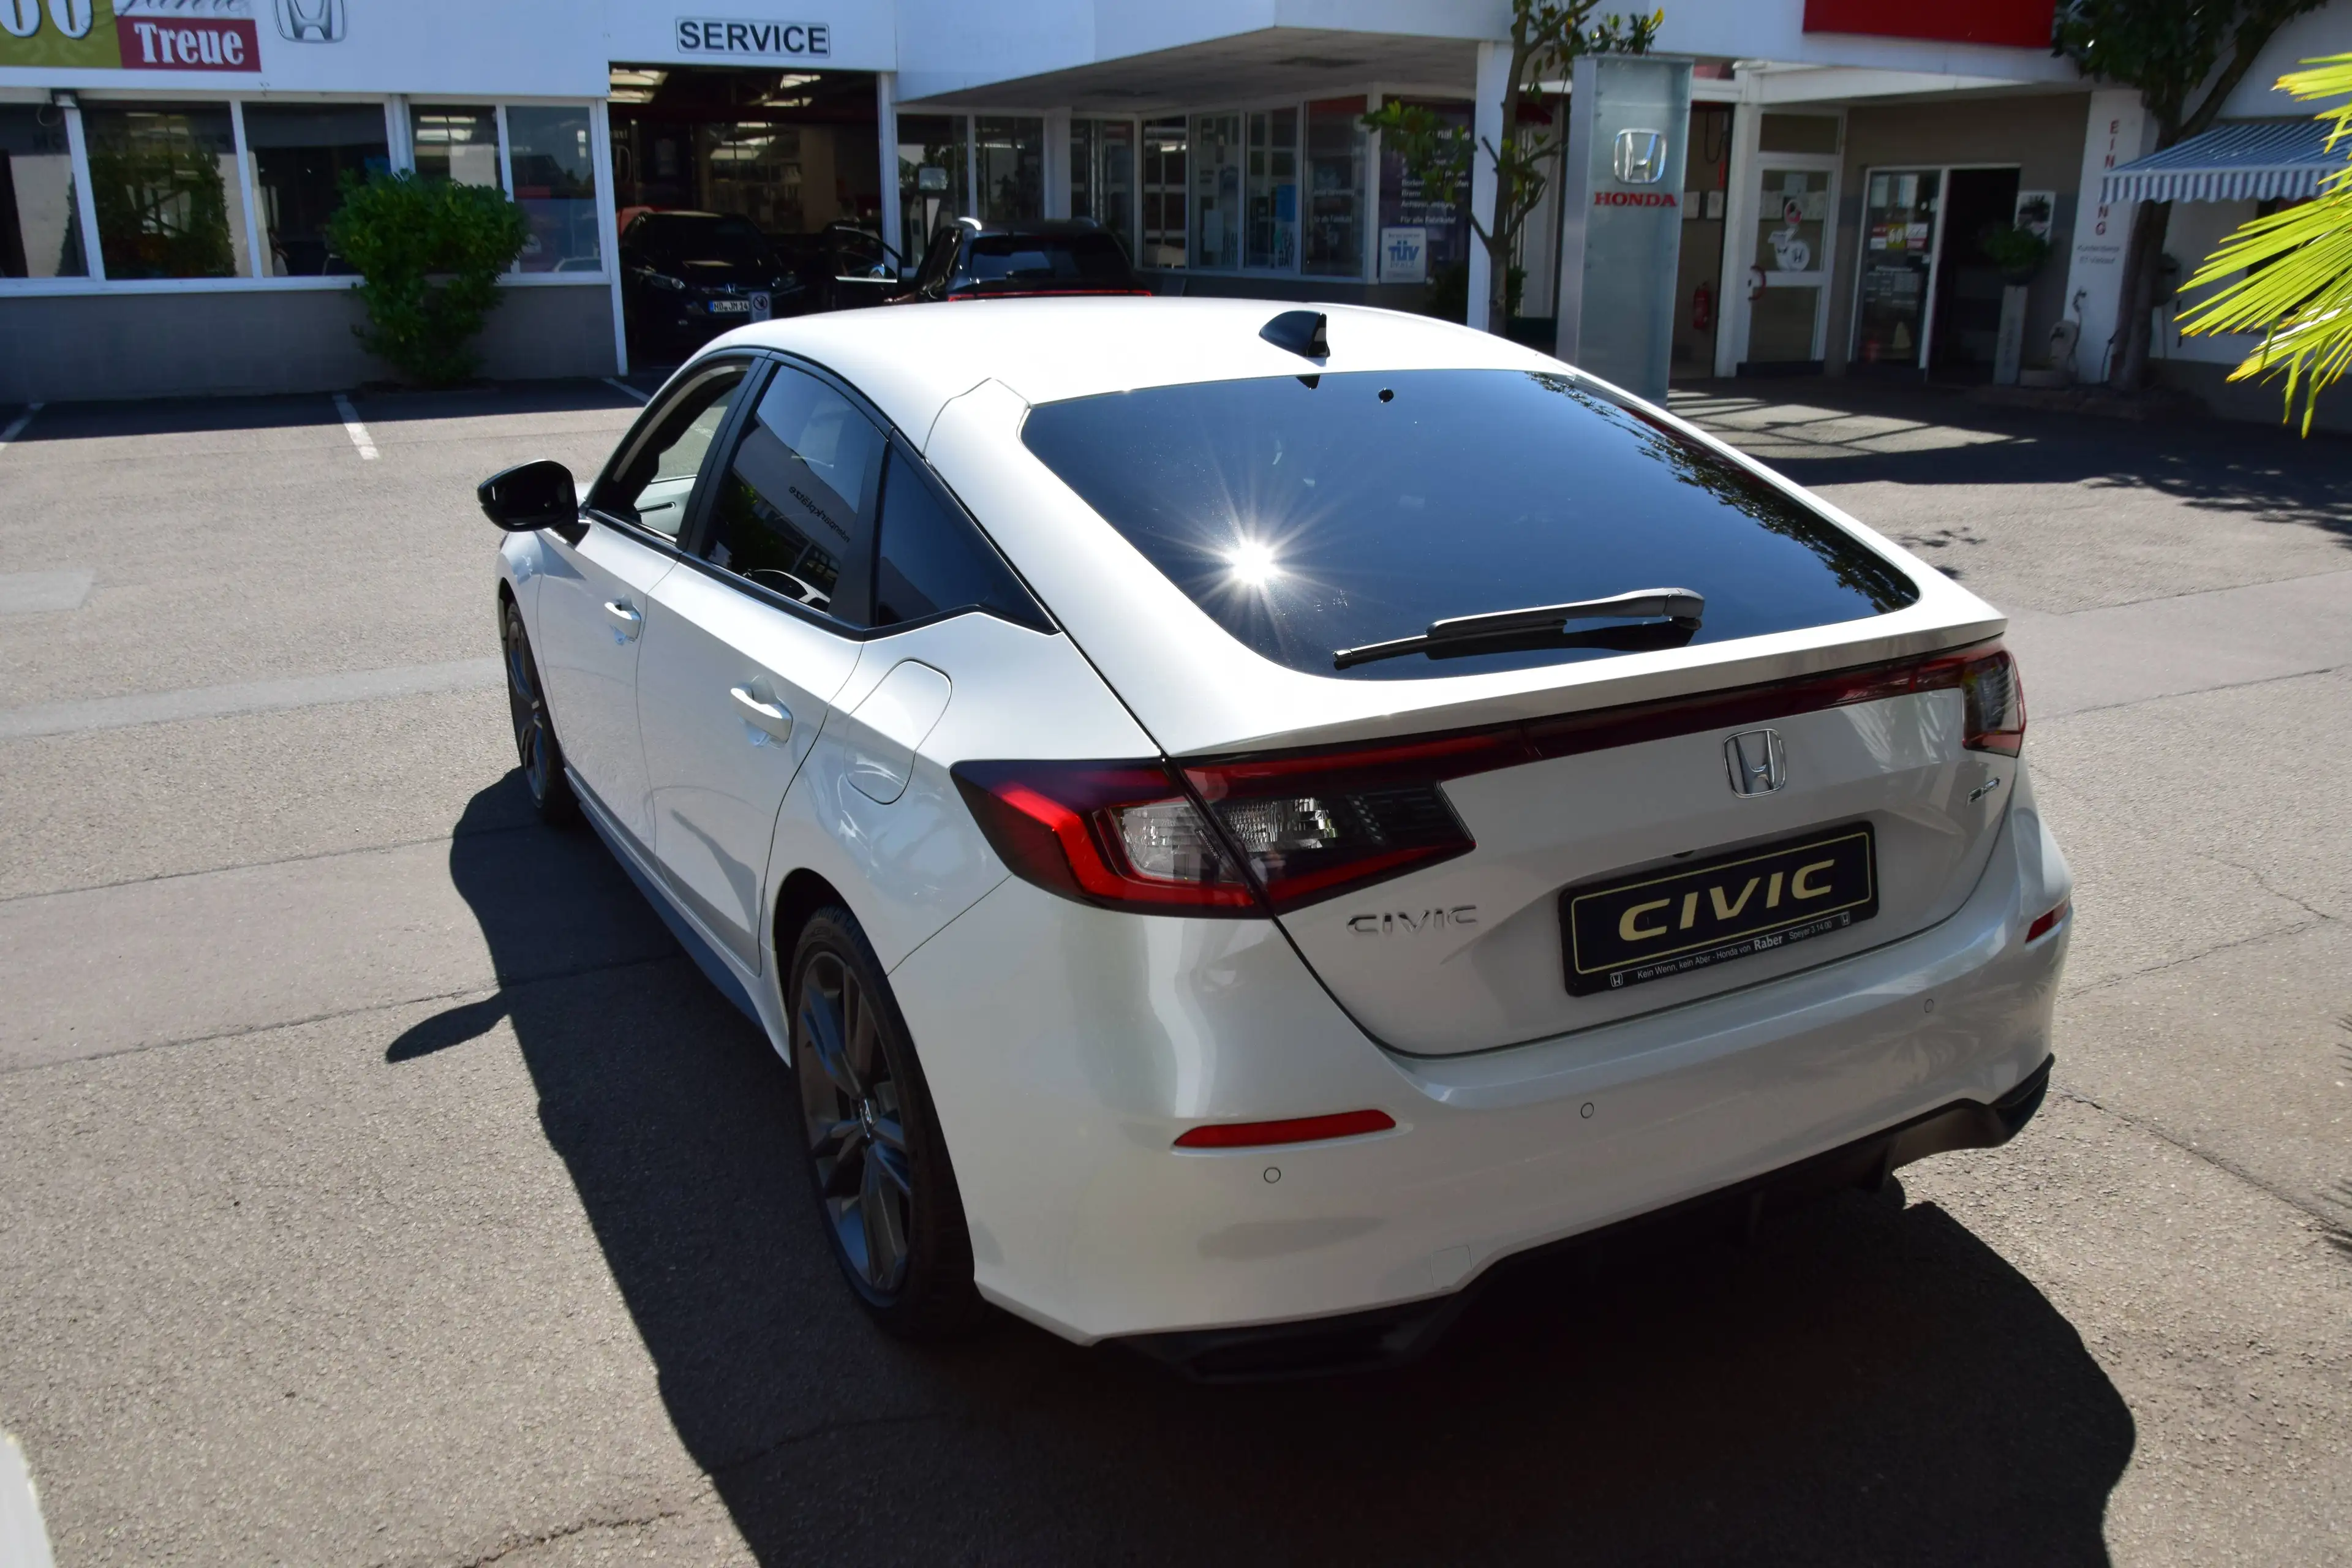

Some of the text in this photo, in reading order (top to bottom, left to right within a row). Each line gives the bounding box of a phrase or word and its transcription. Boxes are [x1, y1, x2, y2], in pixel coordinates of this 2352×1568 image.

[134, 22, 245, 65] Treue
[679, 21, 828, 55] SERVICE
[2095, 119, 2120, 236] EINNG
[1594, 191, 1676, 206] HONDA
[1388, 240, 1420, 261] TÜV
[1619, 859, 1835, 941] CIVIC
[1346, 905, 1477, 935] CIVIC
[1637, 968, 1654, 979] Kein
[1654, 964, 1678, 975] Wenn,
[1679, 959, 1694, 970] kein
[1695, 956, 1710, 965] Aber
[1716, 948, 1738, 960] Honda
[1740, 944, 1751, 954] von
[1754, 935, 1783, 951] Raber
[1789, 929, 1810, 941] Speyer
